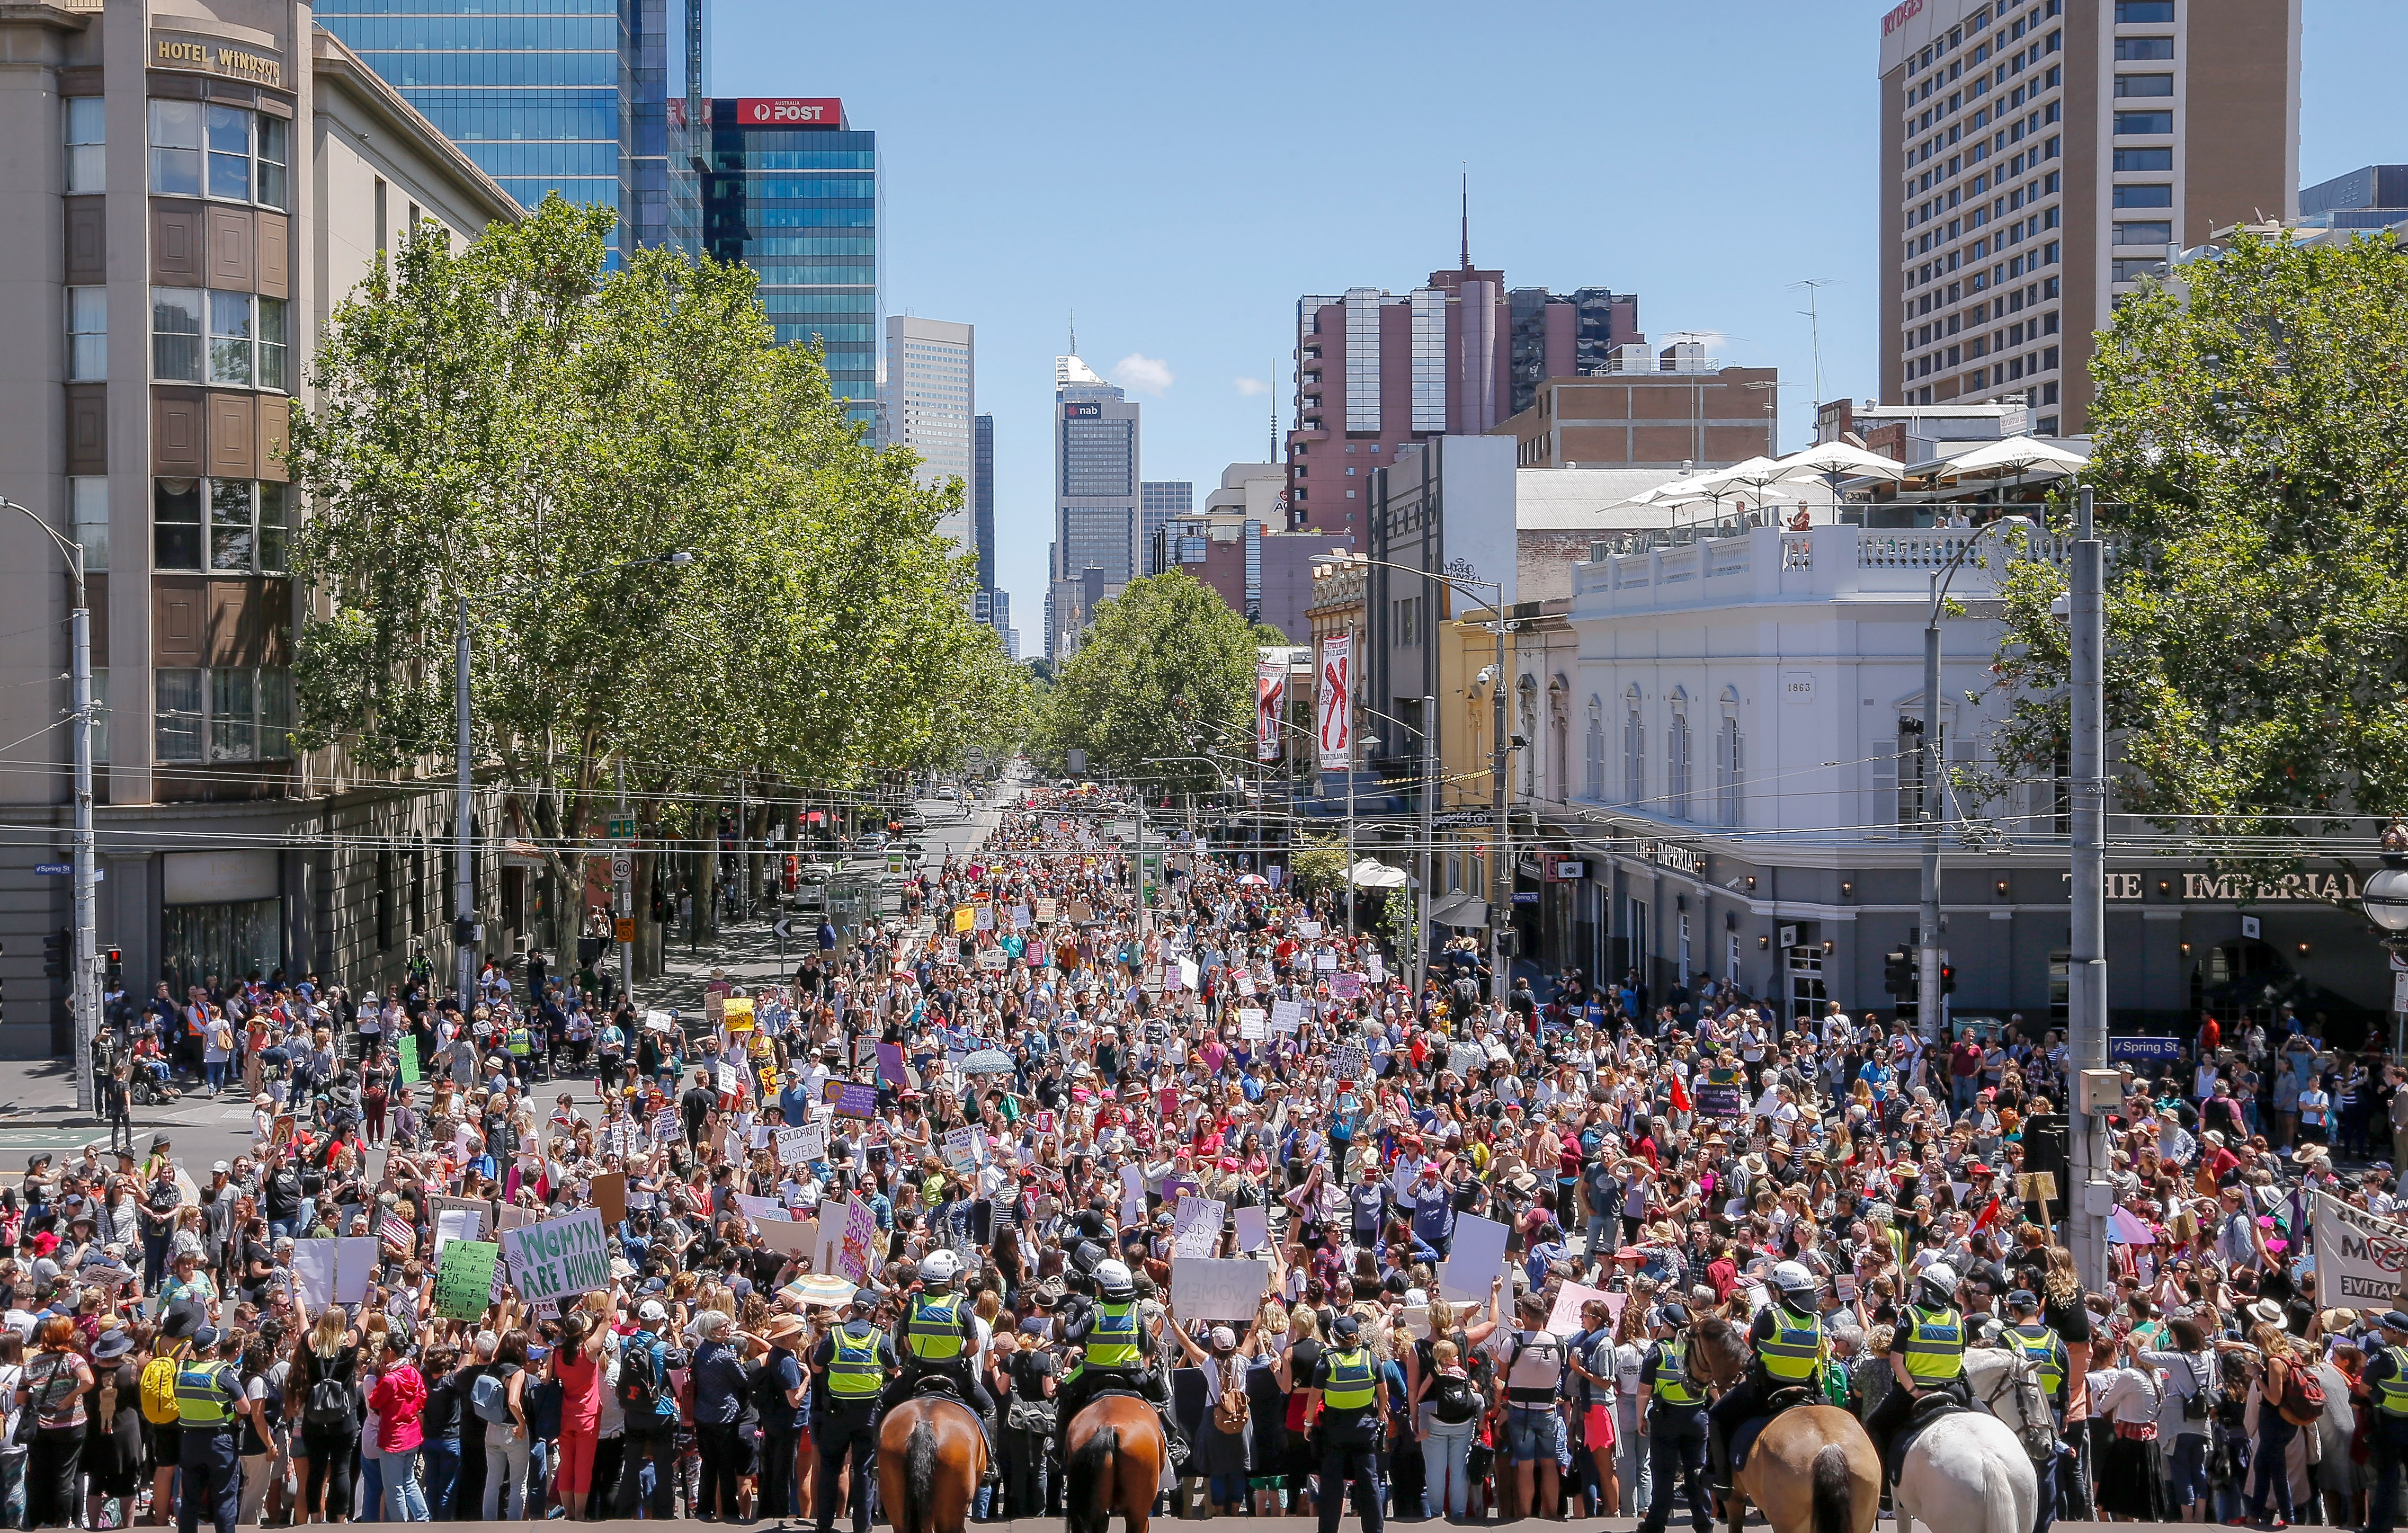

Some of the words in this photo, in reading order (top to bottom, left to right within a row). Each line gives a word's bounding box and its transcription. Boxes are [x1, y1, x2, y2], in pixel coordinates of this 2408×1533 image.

[1884, 0, 1922, 37] RYDGES
[158, 41, 210, 63] HOTEL
[218, 47, 280, 78] WINDSOR
[774, 106, 823, 120] POST
[1079, 406, 1098, 415] nab
[1788, 683, 1810, 692] 1863
[1657, 842, 1698, 875] IMPERIAL
[615, 864, 629, 873] 40
[401, 1037, 417, 1050] LOVE
[2123, 1041, 2161, 1054] Spring
[2164, 1041, 2178, 1051] St
[403, 1061, 418, 1071] HATE
[1333, 1065, 1356, 1073] GRAB
[1330, 1070, 1358, 1081] BAK
[849, 1086, 864, 1095] strong
[659, 1111, 674, 1119] FUCK
[1718, 1107, 1739, 1116] equality
[779, 1124, 819, 1144] SOLIDARITY
[950, 1136, 967, 1145] Black
[781, 1142, 819, 1163] SISTERS
[1187, 1200, 1212, 1219] MY
[849, 1200, 873, 1235] 1848
[845, 1219, 870, 1250] 2017
[1176, 1220, 1215, 1238] BODY
[516, 1217, 601, 1267] WOMYN
[1189, 1234, 1204, 1244] MY
[446, 1241, 458, 1252] This
[460, 1242, 485, 1254] American
[1174, 1242, 1215, 1258] CHOIC
[563, 1247, 612, 1290] HUMAN
[447, 1272, 459, 1286] $15
[522, 1262, 561, 1299] ARE
[444, 1286, 467, 1298] Green
[469, 1289, 485, 1299] Jobs
[444, 1301, 463, 1311] Equal
[466, 1300, 479, 1312] Pay
[440, 1308, 452, 1317] for
[456, 1310, 480, 1319] Women
